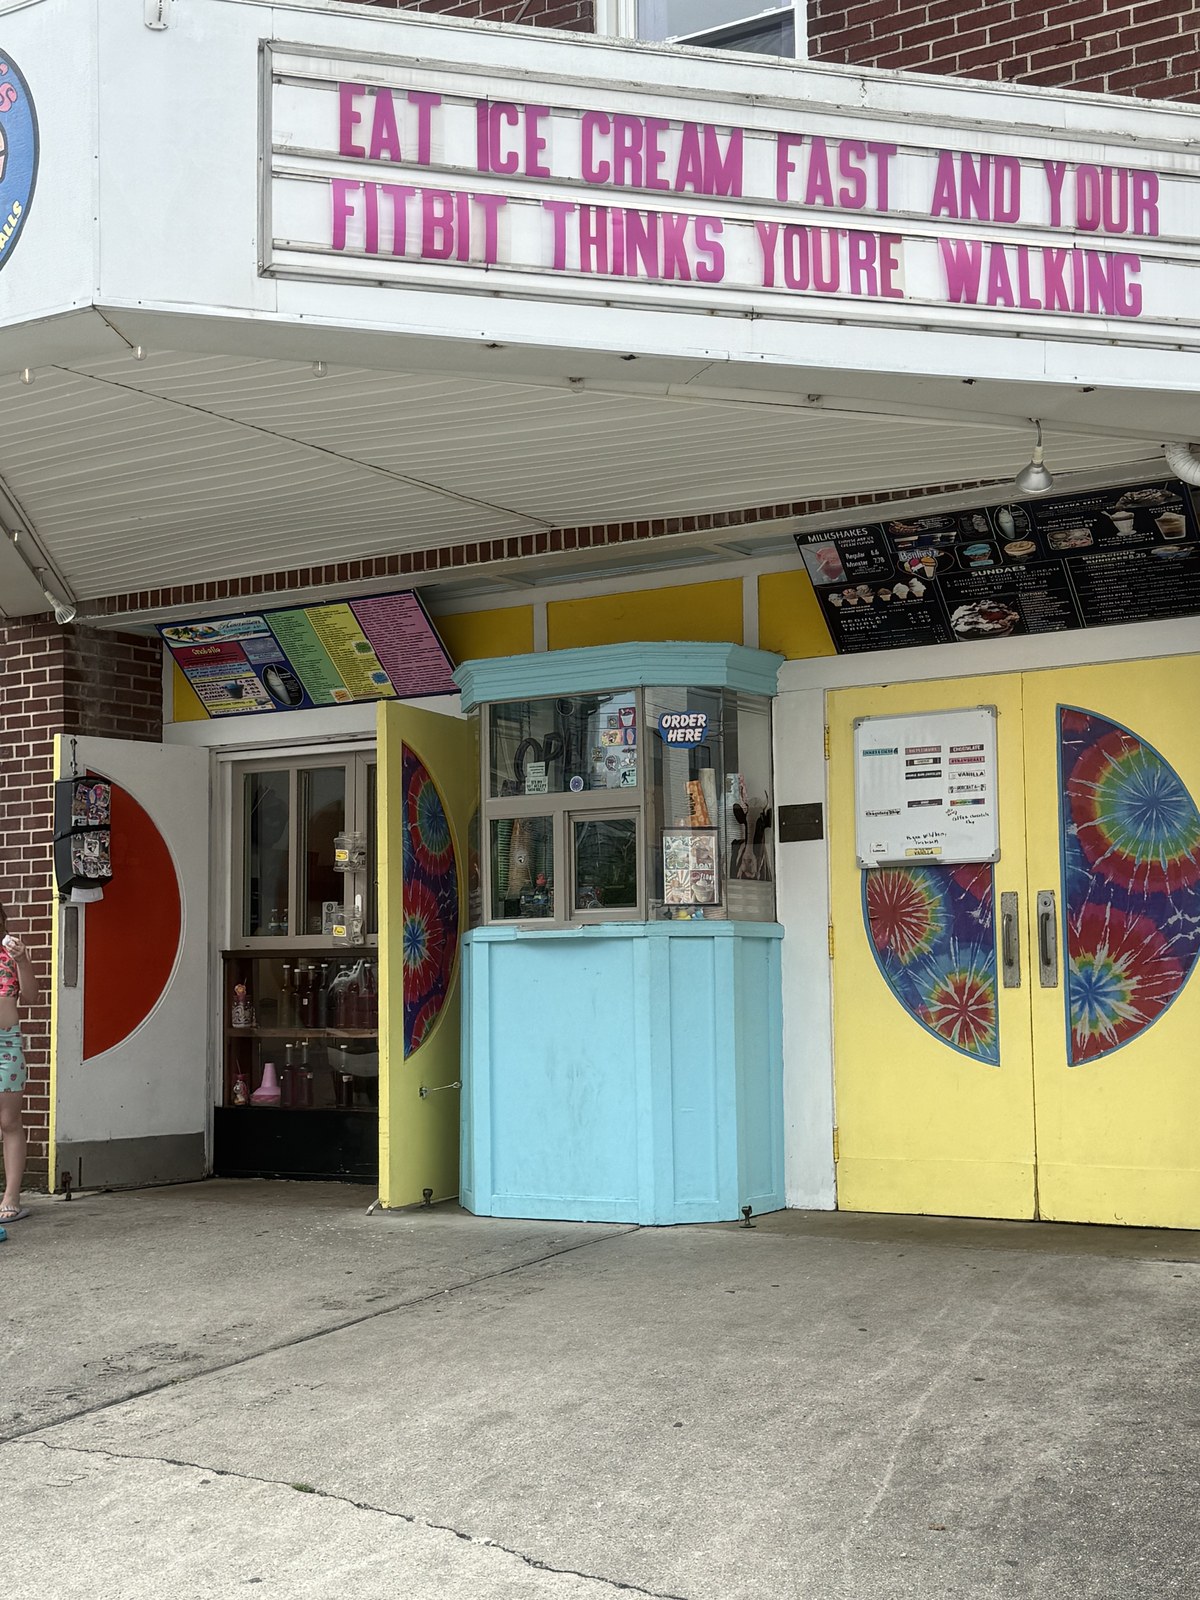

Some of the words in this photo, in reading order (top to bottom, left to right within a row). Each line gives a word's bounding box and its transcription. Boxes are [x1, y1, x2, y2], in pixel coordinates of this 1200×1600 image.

[339, 83, 441, 165] EAT
[476, 101, 550, 178] ICE
[581, 111, 743, 198] CREAM
[776, 132, 897, 212] FAST
[931, 151, 1021, 224] AND
[1044, 160, 1159, 237] YOUR
[332, 179, 507, 265] FITBIT
[543, 201, 725, 283] THINKS
[756, 222, 904, 298] YOU'RE
[938, 237, 1143, 317] WALKING
[807, 527, 868, 543] MILKSHAKES
[970, 565, 1027, 577] SUNDAES
[662, 714, 706, 728] ORDER
[668, 728, 703, 742] HERE
